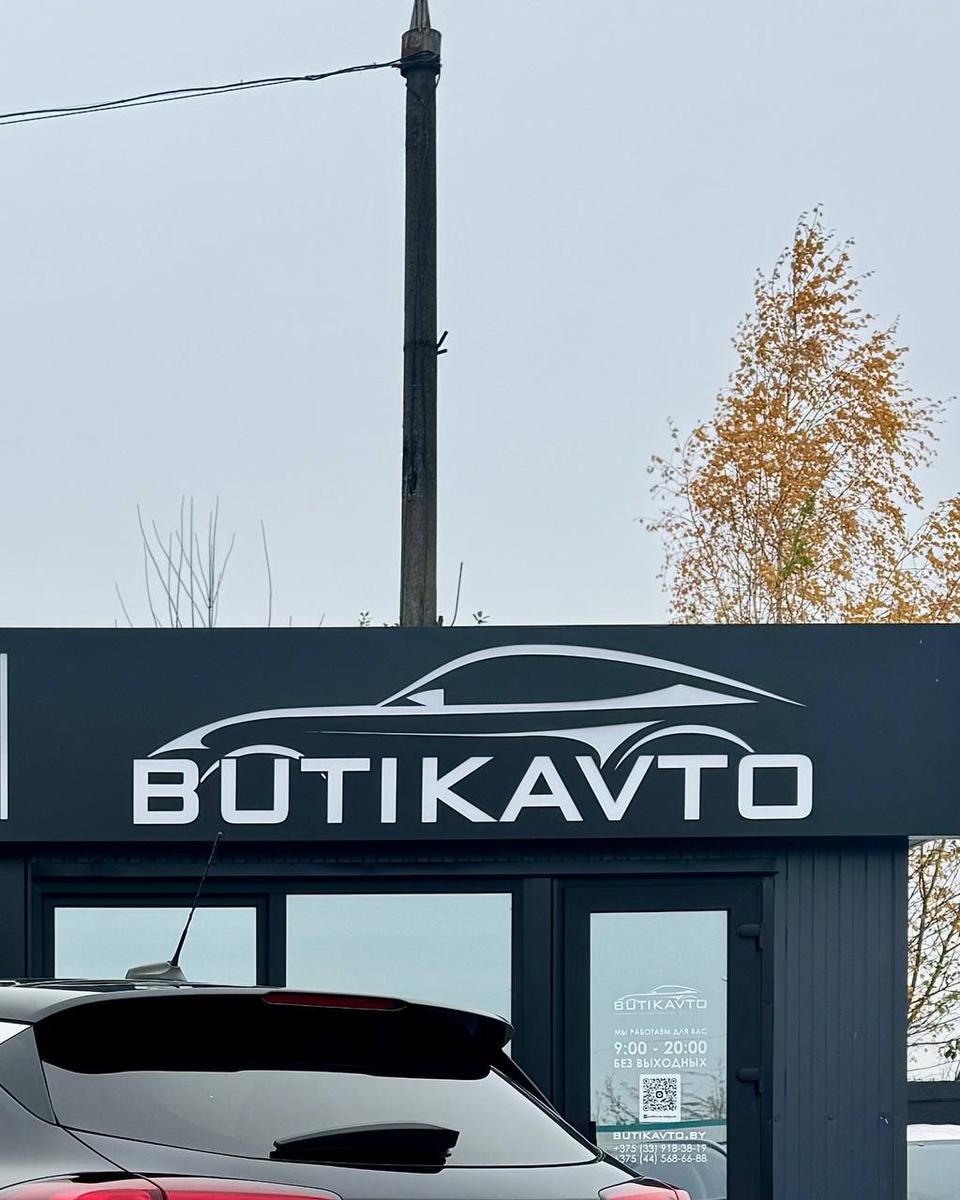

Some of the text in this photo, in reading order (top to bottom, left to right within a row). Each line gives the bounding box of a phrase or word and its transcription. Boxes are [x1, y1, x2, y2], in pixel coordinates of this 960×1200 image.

[132, 753, 813, 825] BUTIKAVTO
[614, 999, 707, 1010] BUTIKAVTO
[614, 1041, 647, 1055] 9:00
[664, 1040, 707, 1055] 20:00
[614, 1058, 707, 1069] БЕЗ ВЫХОДНЫХ
[613, 1131, 706, 1140] BUTIKAVTO.BY
[613, 1144, 708, 1154] +375 (33) 918-38-19
[640, 1154, 657, 1165] (44)
[661, 1154, 708, 1163] 568-66-88
